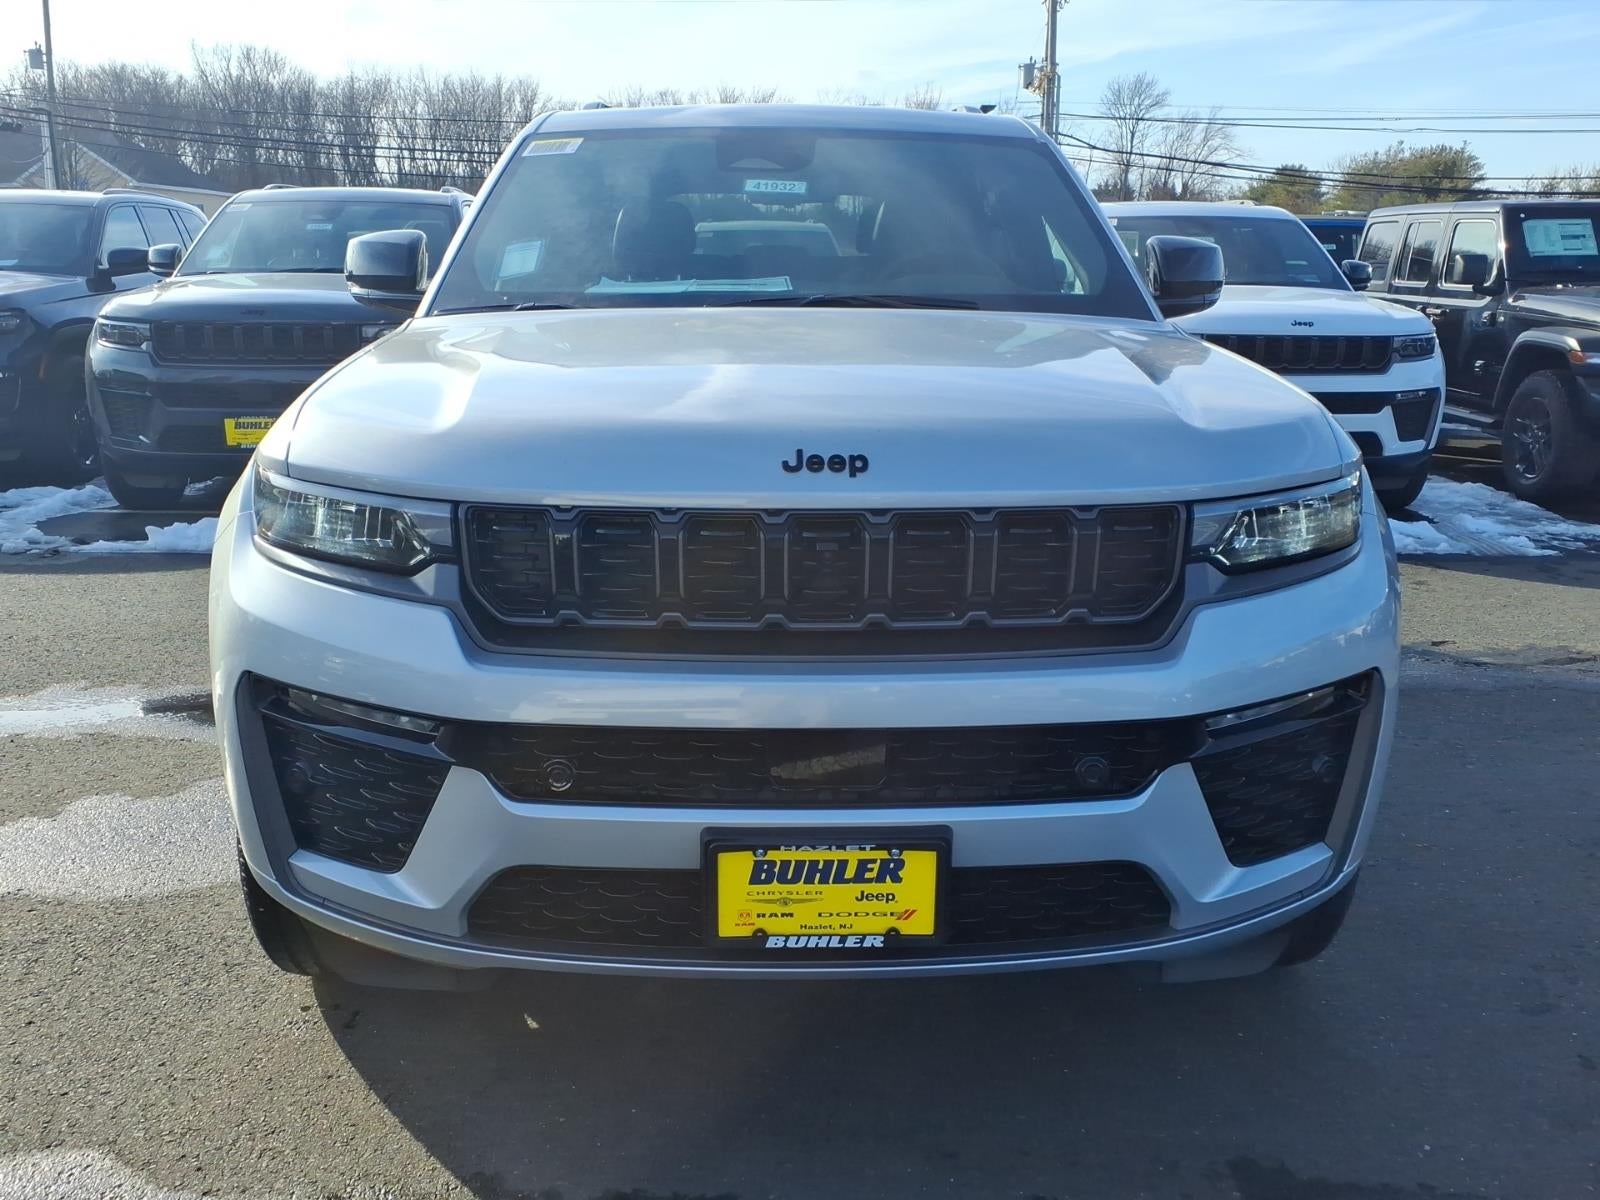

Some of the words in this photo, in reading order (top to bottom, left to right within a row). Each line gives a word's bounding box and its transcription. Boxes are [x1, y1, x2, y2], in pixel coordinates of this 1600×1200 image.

[752, 182, 796, 191] 41932
[1291, 319, 1314, 327] Jeep
[782, 448, 869, 478] Jeep
[779, 844, 877, 852] HAZLET
[748, 858, 906, 886] BUHLER
[855, 890, 896, 904] Jeep
[764, 935, 885, 948] BUHLER
